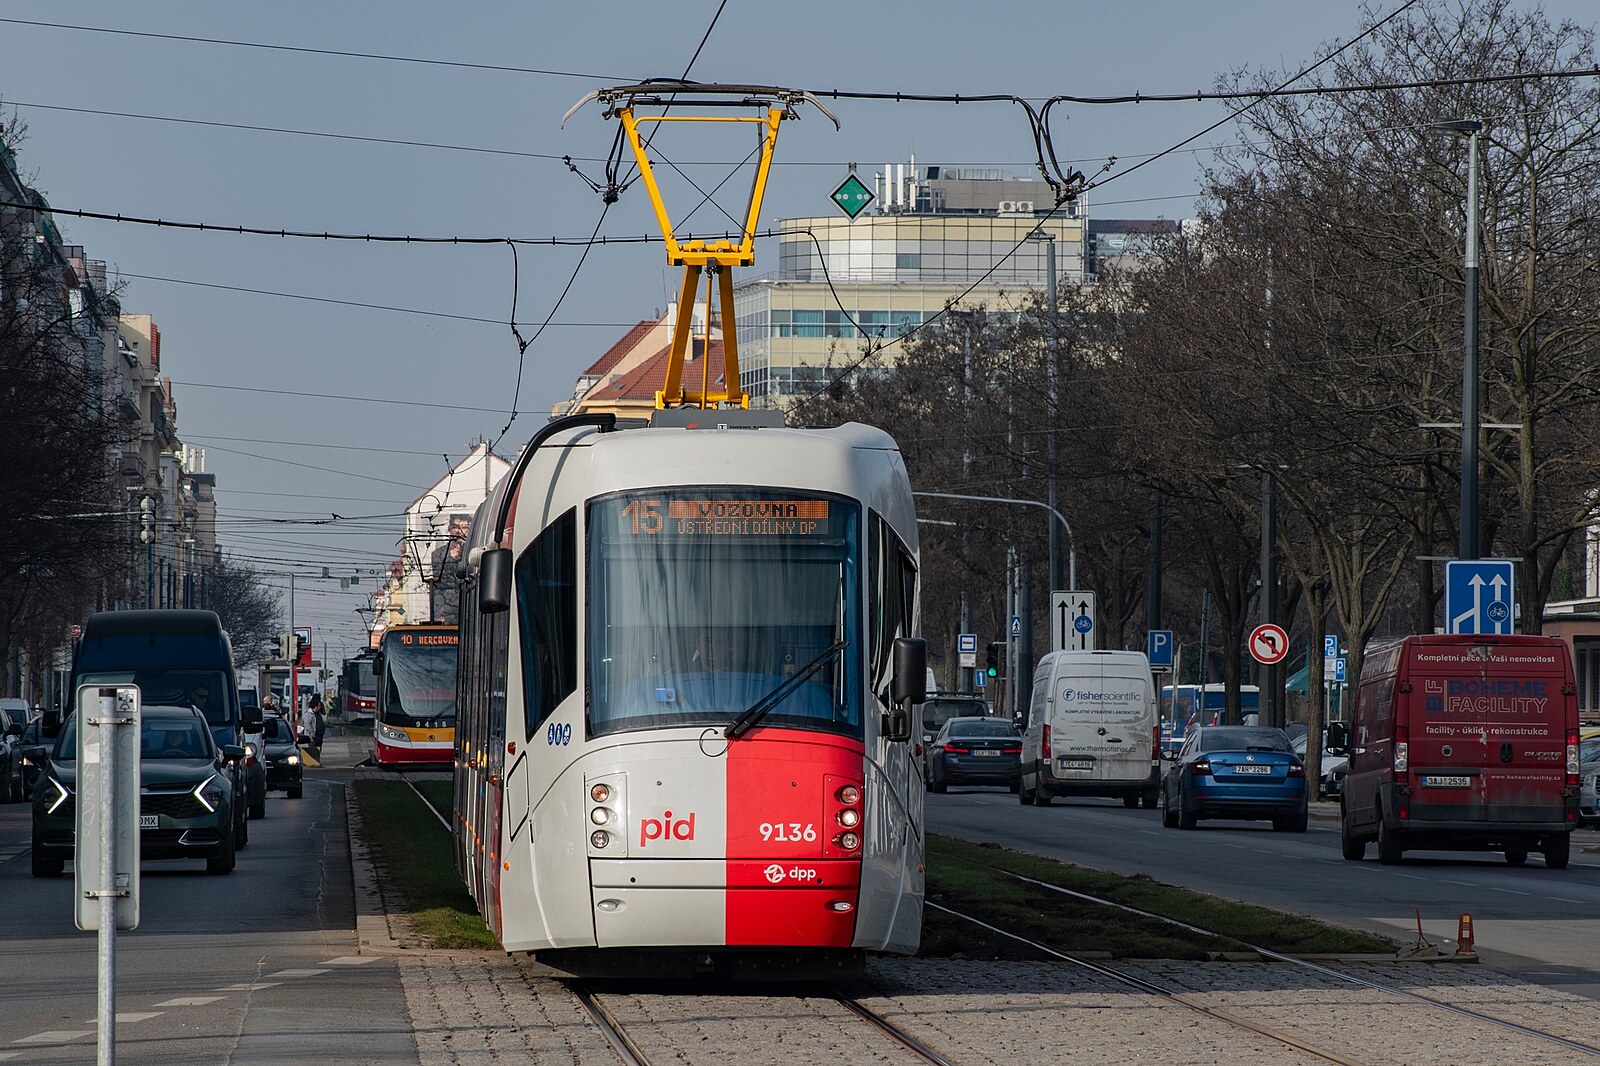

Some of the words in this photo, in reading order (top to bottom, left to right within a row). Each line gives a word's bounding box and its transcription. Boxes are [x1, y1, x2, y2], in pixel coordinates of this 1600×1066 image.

[621, 500, 664, 535] 15
[698, 503, 798, 517] VOZOVNA
[677, 518, 748, 535] ÚSTŘEDNÍ
[752, 518, 795, 535] DÍLNY
[800, 522, 817, 535] DP
[401, 635, 413, 645] 10
[1154, 634, 1166, 653] P
[1417, 654, 1459, 662] Kompletní
[1448, 680, 1549, 697] BOHEME
[1448, 696, 1548, 714] FACILITY
[1426, 726, 1455, 735] facility
[1462, 726, 1484, 734] úklid
[1491, 727, 1548, 735] rekonstrukce
[640, 810, 696, 847] pid
[758, 823, 817, 842] 9136
[788, 866, 816, 881] dpp
